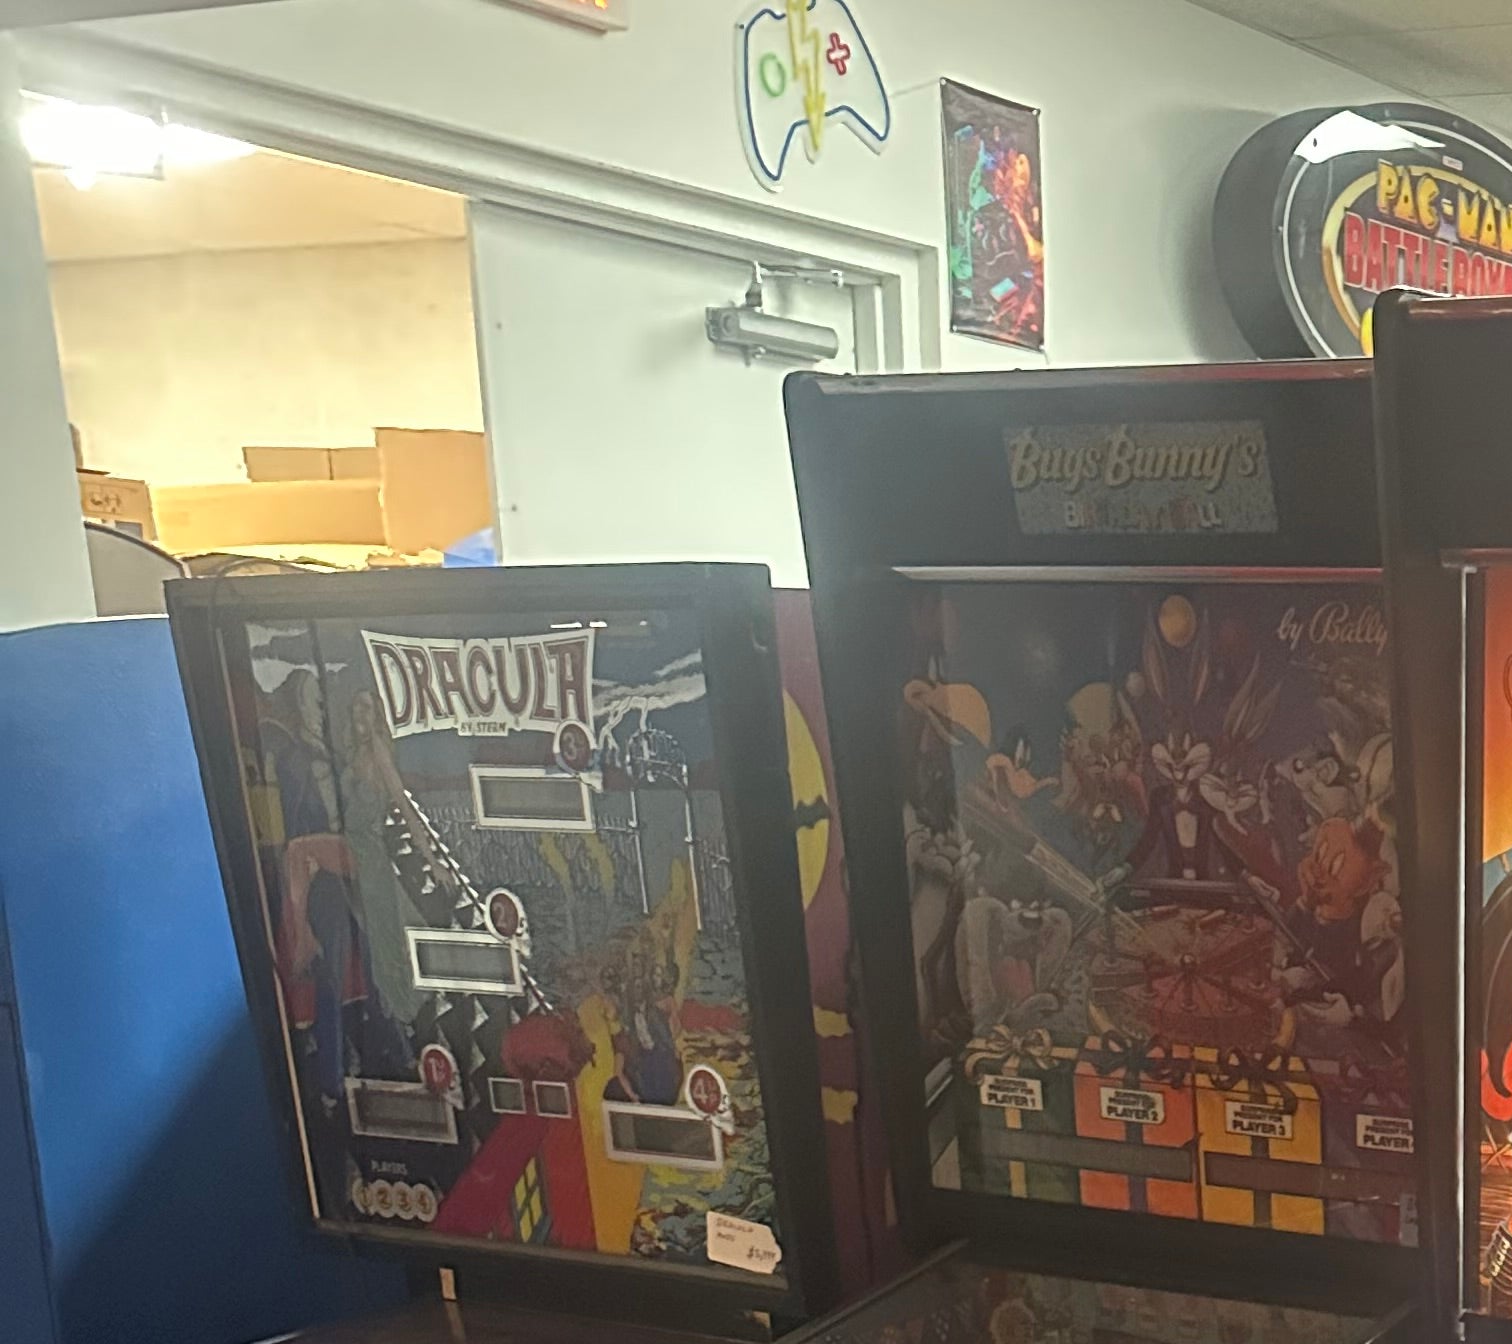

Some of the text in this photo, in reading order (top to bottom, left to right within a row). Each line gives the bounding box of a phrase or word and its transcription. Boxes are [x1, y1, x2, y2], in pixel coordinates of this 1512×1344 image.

[1344, 211, 1449, 295] BATTLE
[1009, 424, 1260, 494] Bugs Bunny's
[1278, 600, 1388, 657] by Bally
[368, 636, 588, 727] DRACULA
[987, 1092, 1029, 1107] PLAYER
[1107, 1106, 1150, 1121] PLAYER
[1232, 1119, 1277, 1135] PLAYER
[1363, 1134, 1410, 1149] PLAYER
